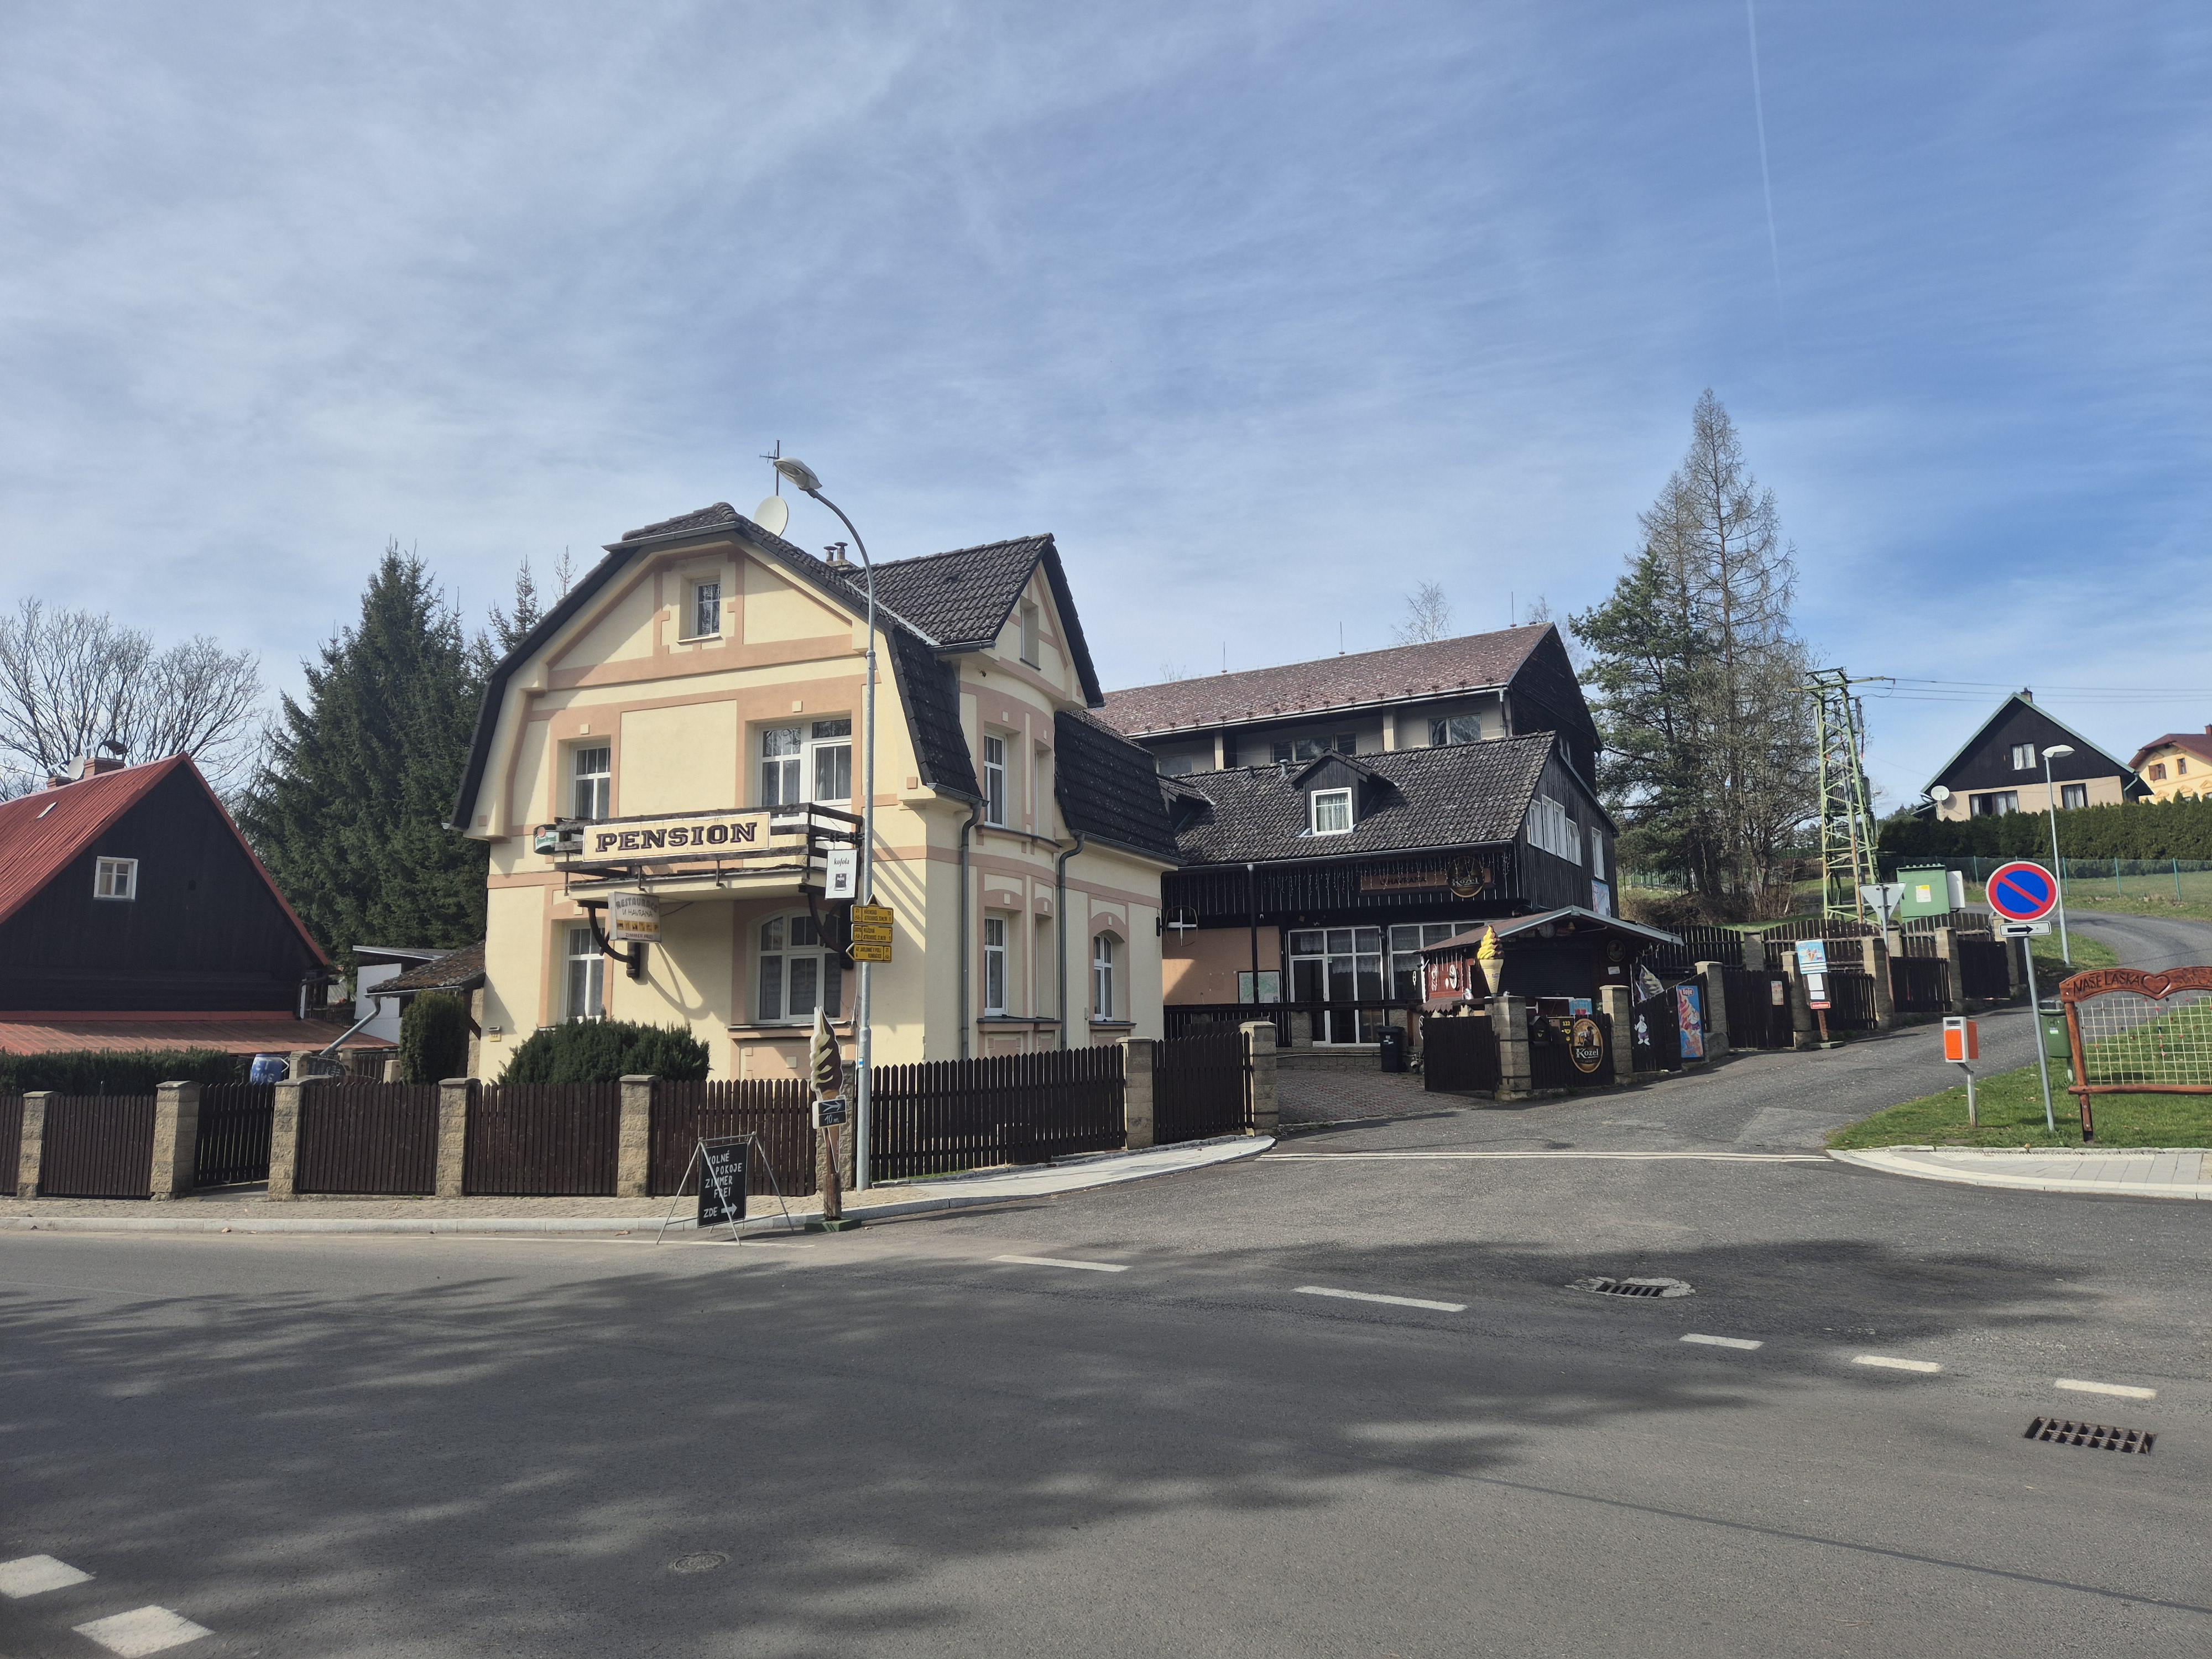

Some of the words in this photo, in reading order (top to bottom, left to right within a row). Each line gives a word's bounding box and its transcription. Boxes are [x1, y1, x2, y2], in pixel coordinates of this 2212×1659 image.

[595, 822, 757, 852] PENSION
[834, 858, 849, 867] kofola
[1452, 877, 1479, 886] Kozel
[615, 897, 658, 912] RESTAURACE
[628, 909, 653, 917] HAVRANA
[2074, 973, 2101, 994] NAŠE
[1576, 1048, 1599, 1058] Kozel
[825, 1114, 832, 1124] 10
[715, 1162, 743, 1176] POKOJE
[705, 1175, 733, 1188] ZIMMER
[703, 1207, 718, 1218] ZDE
